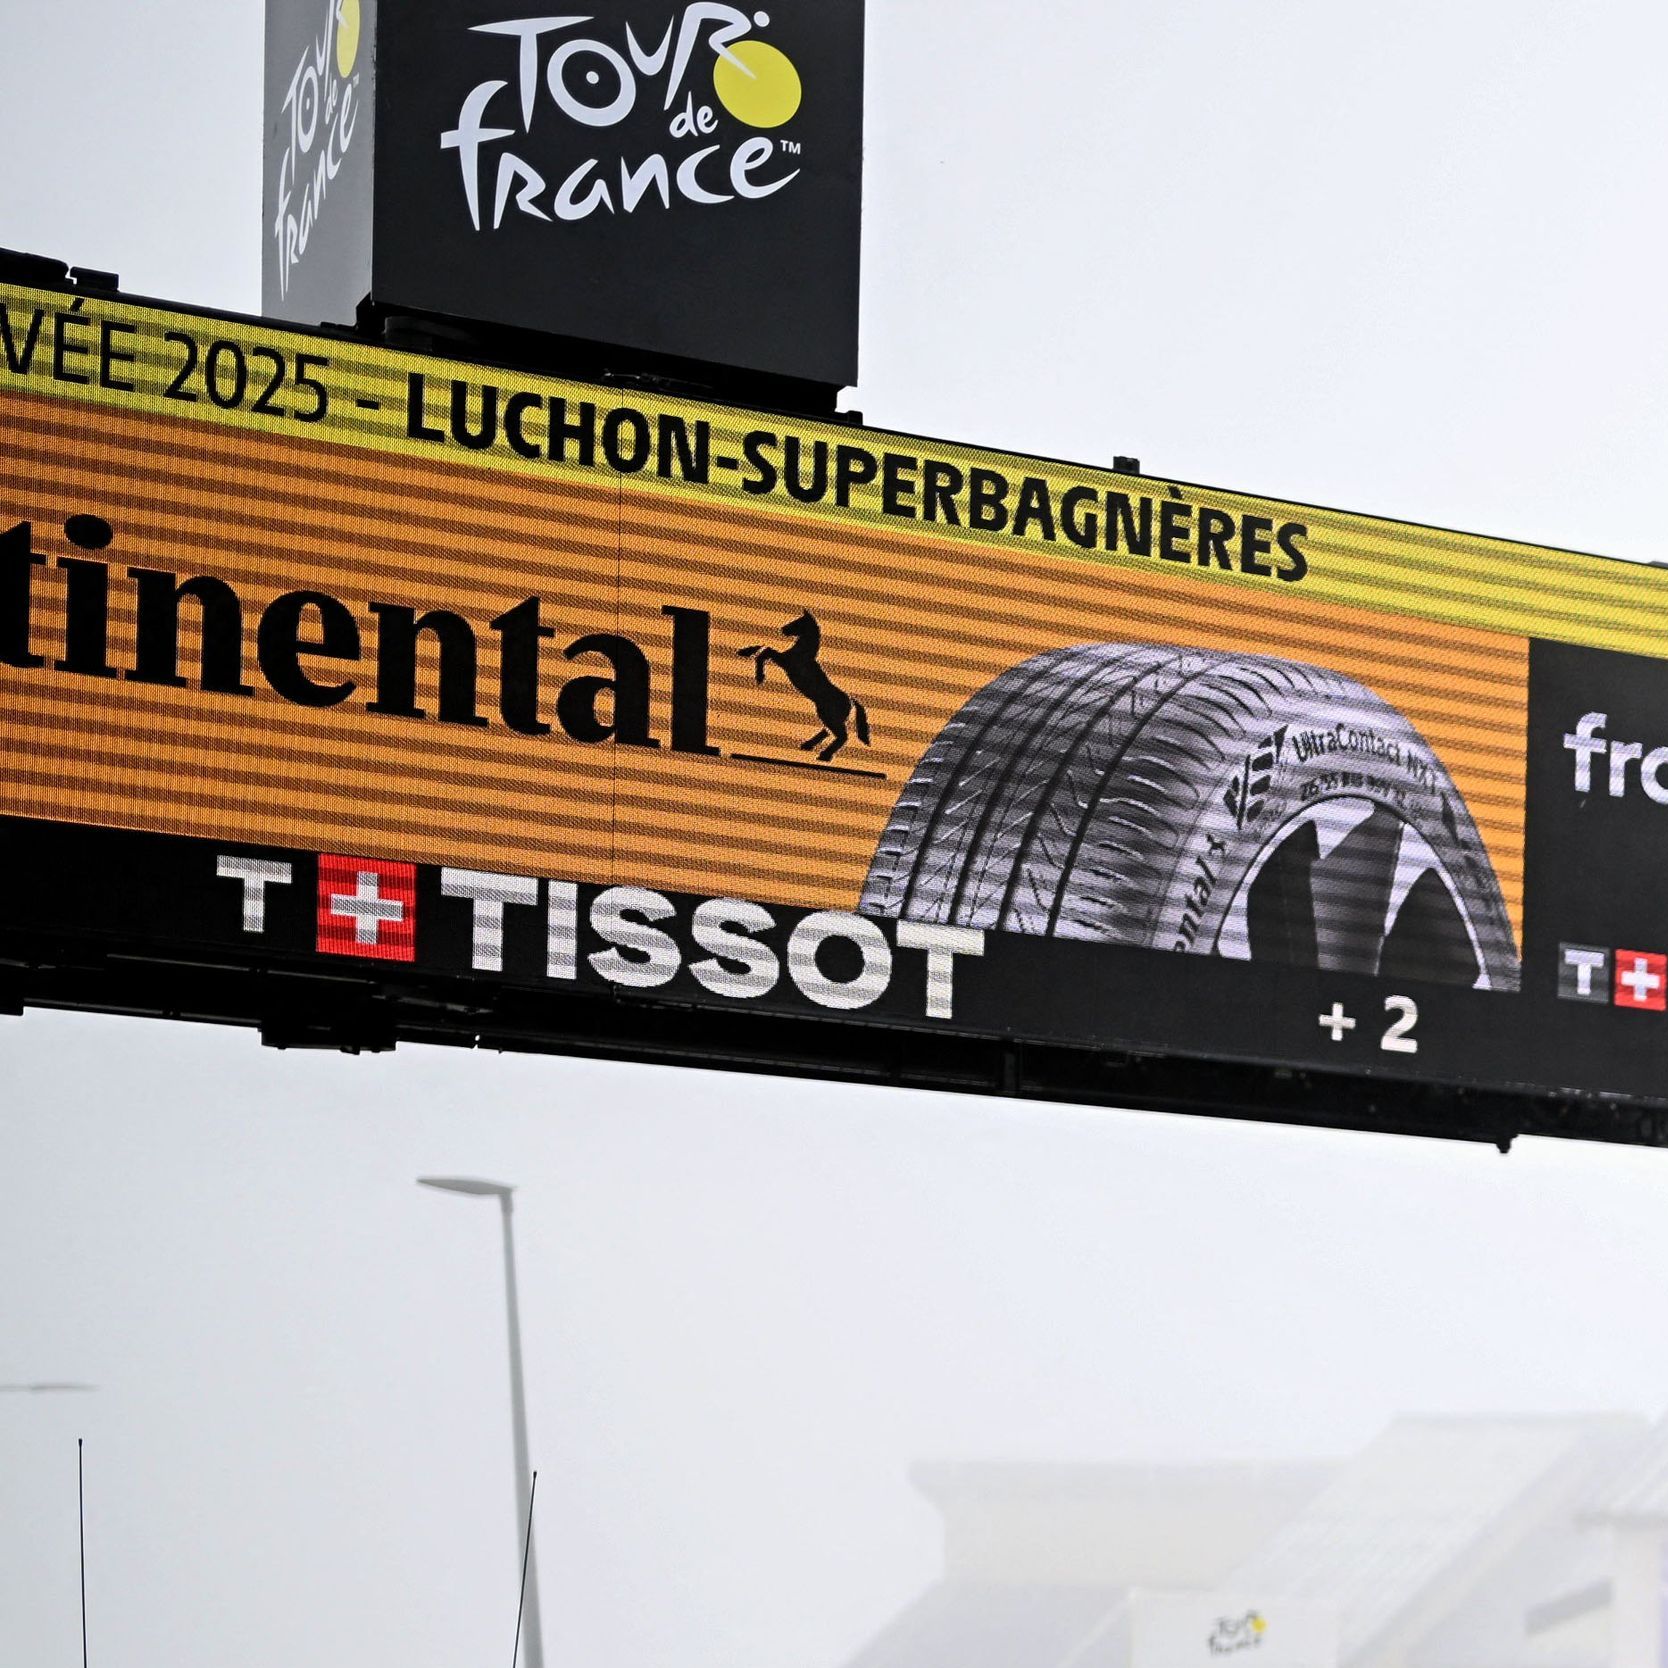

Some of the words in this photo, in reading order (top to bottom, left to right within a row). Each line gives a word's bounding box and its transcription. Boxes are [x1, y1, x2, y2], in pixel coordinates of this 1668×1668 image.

[440, 80, 800, 231] france
[670, 100, 717, 139] de
[162, 328, 329, 424] 2025
[406, 371, 1309, 582] LUCHON-SUPERBAGNÈRES
[440, 868, 985, 1019] TISSOT
[1382, 995, 1418, 1053] 2
